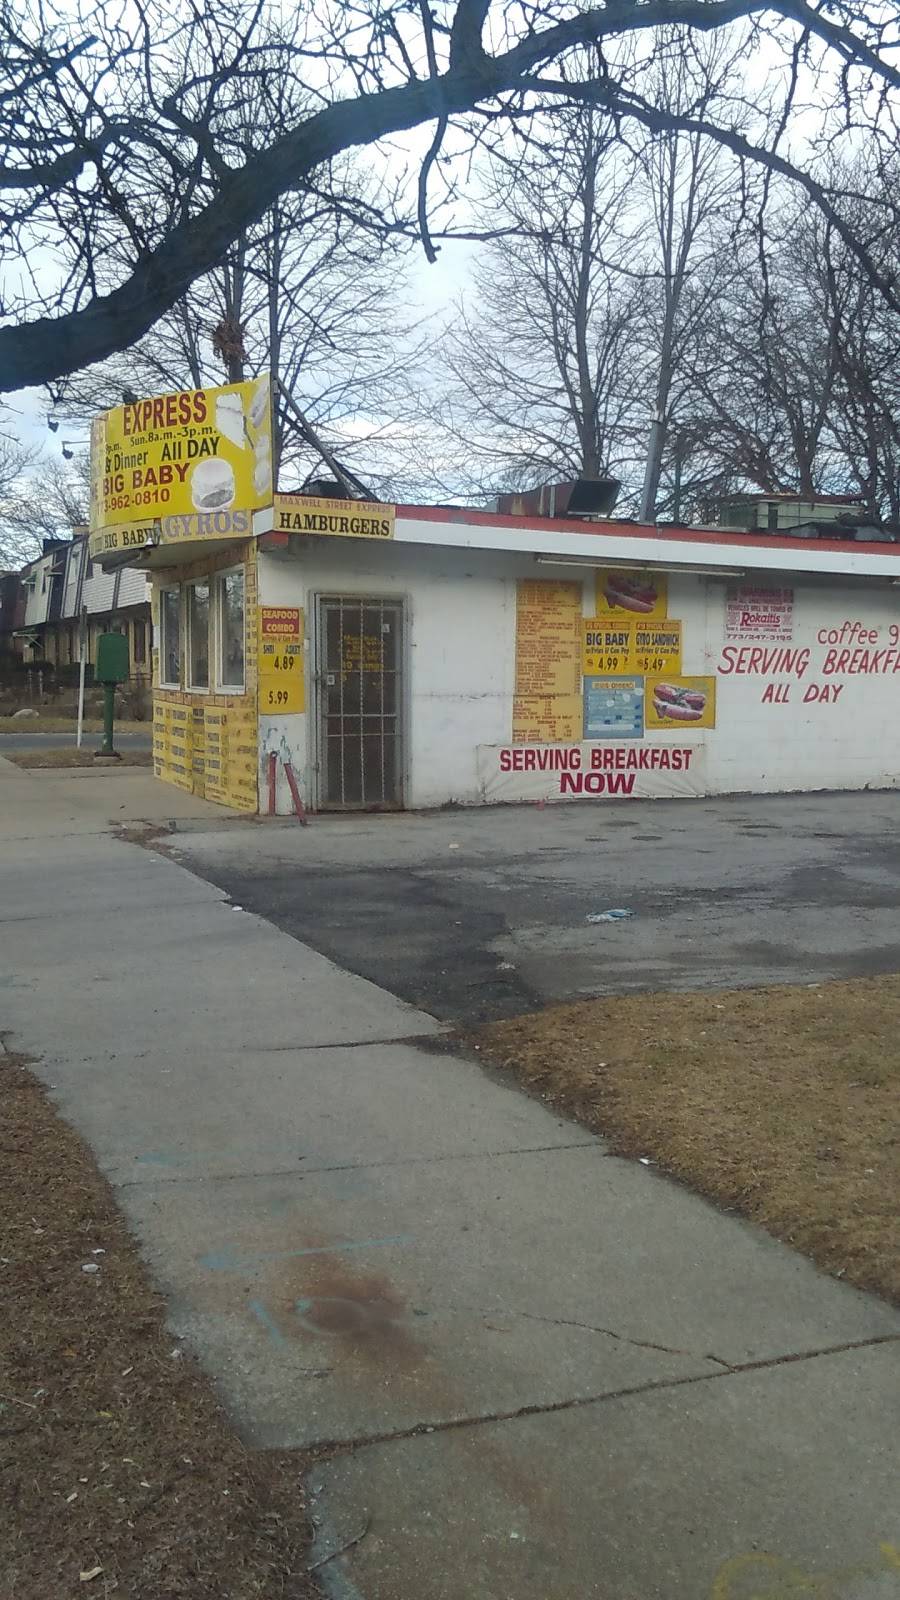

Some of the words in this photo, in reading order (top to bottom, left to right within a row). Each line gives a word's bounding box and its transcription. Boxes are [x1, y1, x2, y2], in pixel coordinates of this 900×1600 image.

[123, 391, 207, 436] EXPRESS
[114, 452, 149, 472] Dinner
[187, 436, 221, 459] DAY
[103, 474, 125, 496] BIG
[132, 462, 191, 489] BABY
[280, 496, 321, 508] MAXWELL
[327, 500, 352, 510] STREET
[164, 510, 249, 538] GYROS
[280, 512, 390, 536] HAMBURGERS
[104, 532, 118, 548] BIG
[262, 610, 299, 620] SEAFOOD
[740, 611, 781, 627] Rokaitis
[266, 623, 295, 632] COMBO
[817, 621, 879, 645] coffee
[586, 633, 602, 646] BIG
[605, 633, 629, 646] BABY
[274, 656, 294, 670] 4.89
[717, 646, 810, 679] SERVING
[269, 691, 288, 704] 5.99
[761, 684, 791, 704] ALL
[803, 684, 843, 704] DAY
[500, 748, 581, 772] SERVING
[591, 749, 692, 770] BREAKFAST
[560, 773, 636, 794] NOW
